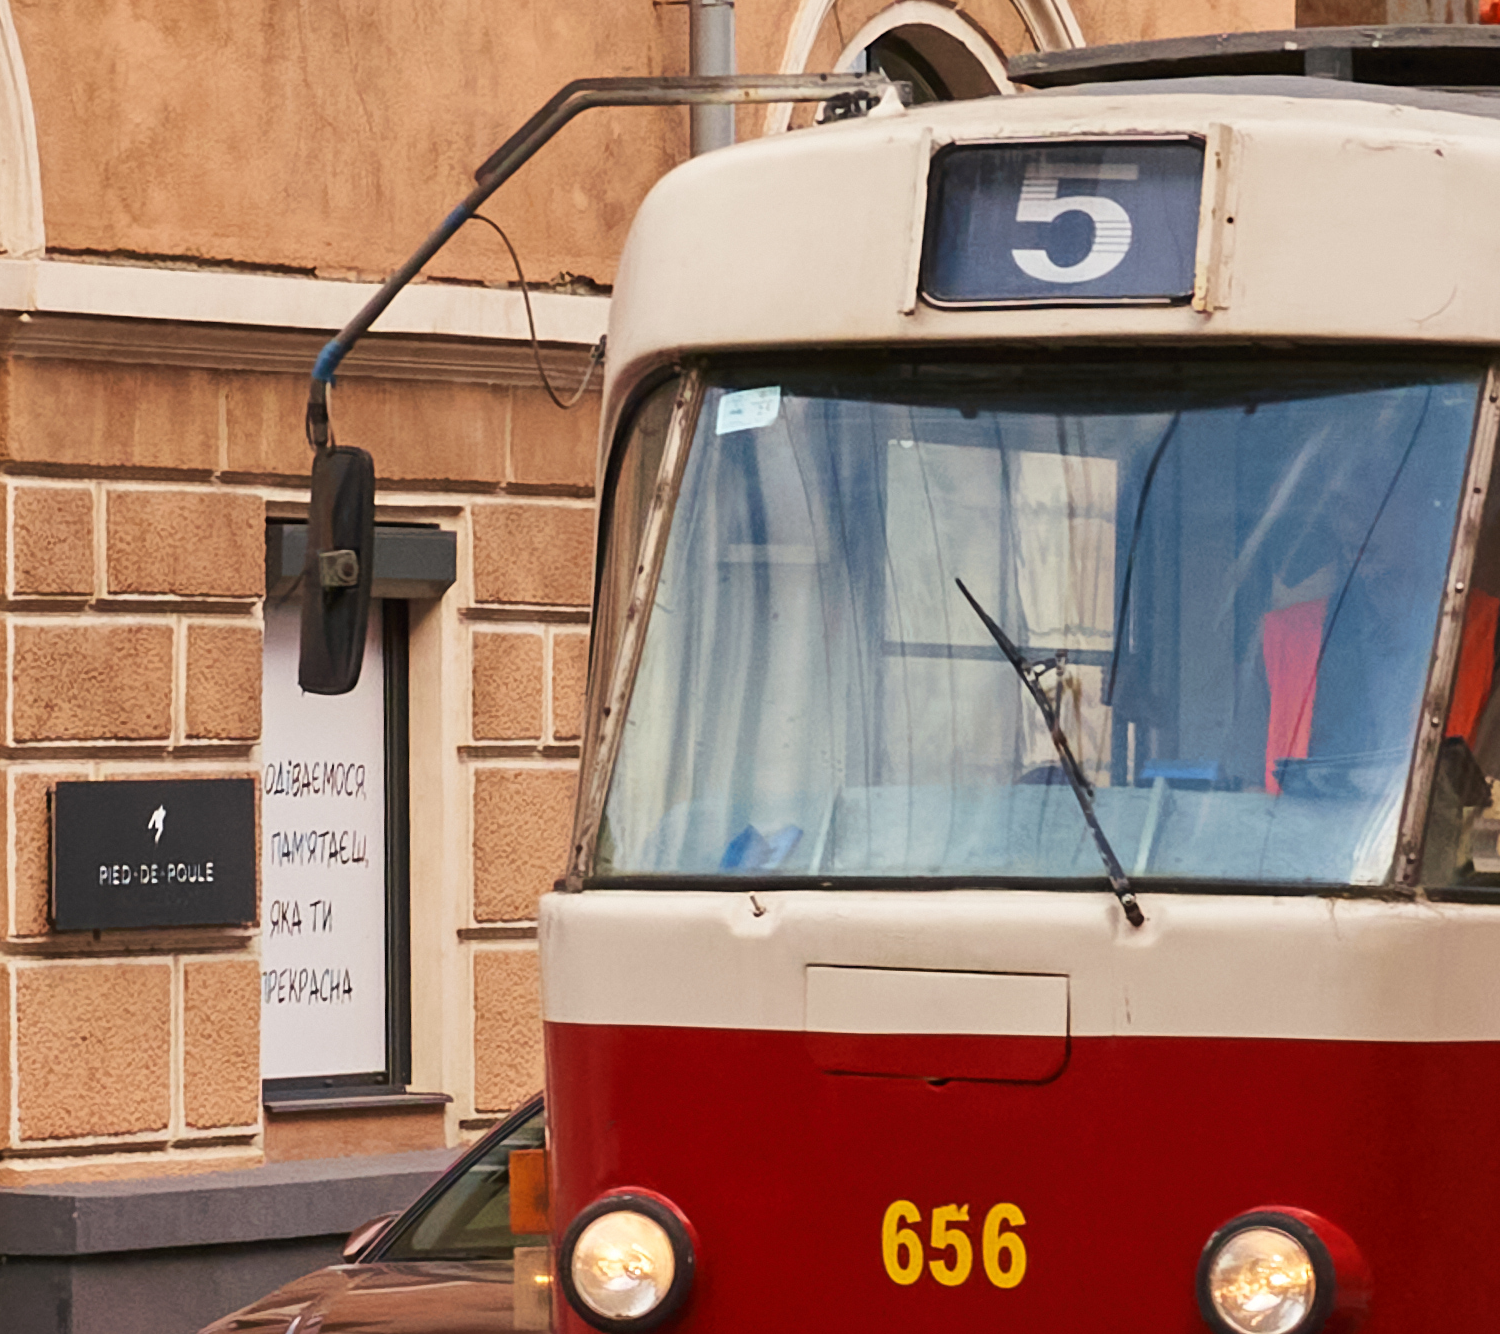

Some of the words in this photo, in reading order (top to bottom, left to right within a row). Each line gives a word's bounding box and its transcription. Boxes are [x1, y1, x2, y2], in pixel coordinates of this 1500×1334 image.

[1011, 164, 1140, 283] 5
[270, 899, 302, 938] ЯКА
[309, 899, 333, 933] ТИ
[882, 1199, 1028, 1289] 656
